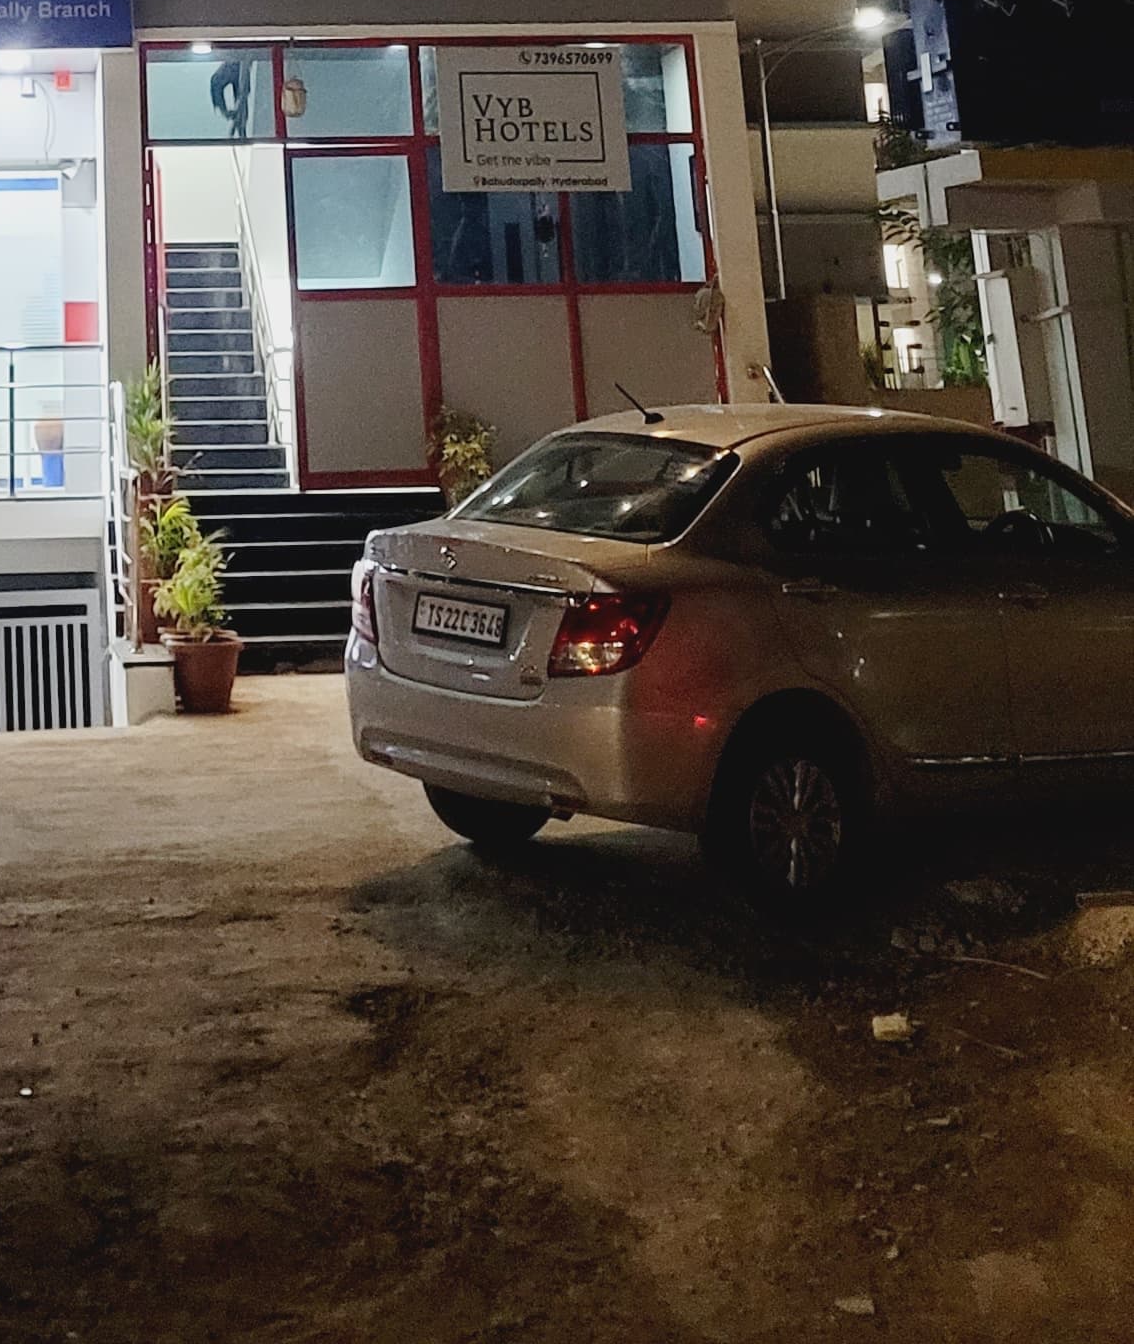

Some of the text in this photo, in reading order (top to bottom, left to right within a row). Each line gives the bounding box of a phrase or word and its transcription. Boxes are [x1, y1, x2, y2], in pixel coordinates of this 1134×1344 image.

[37, 0, 112, 20] Branch
[533, 50, 613, 65] 7396570699
[472, 93, 535, 119] VYB
[474, 118, 594, 143] HOTELS
[476, 153, 552, 166] Get the vibe
